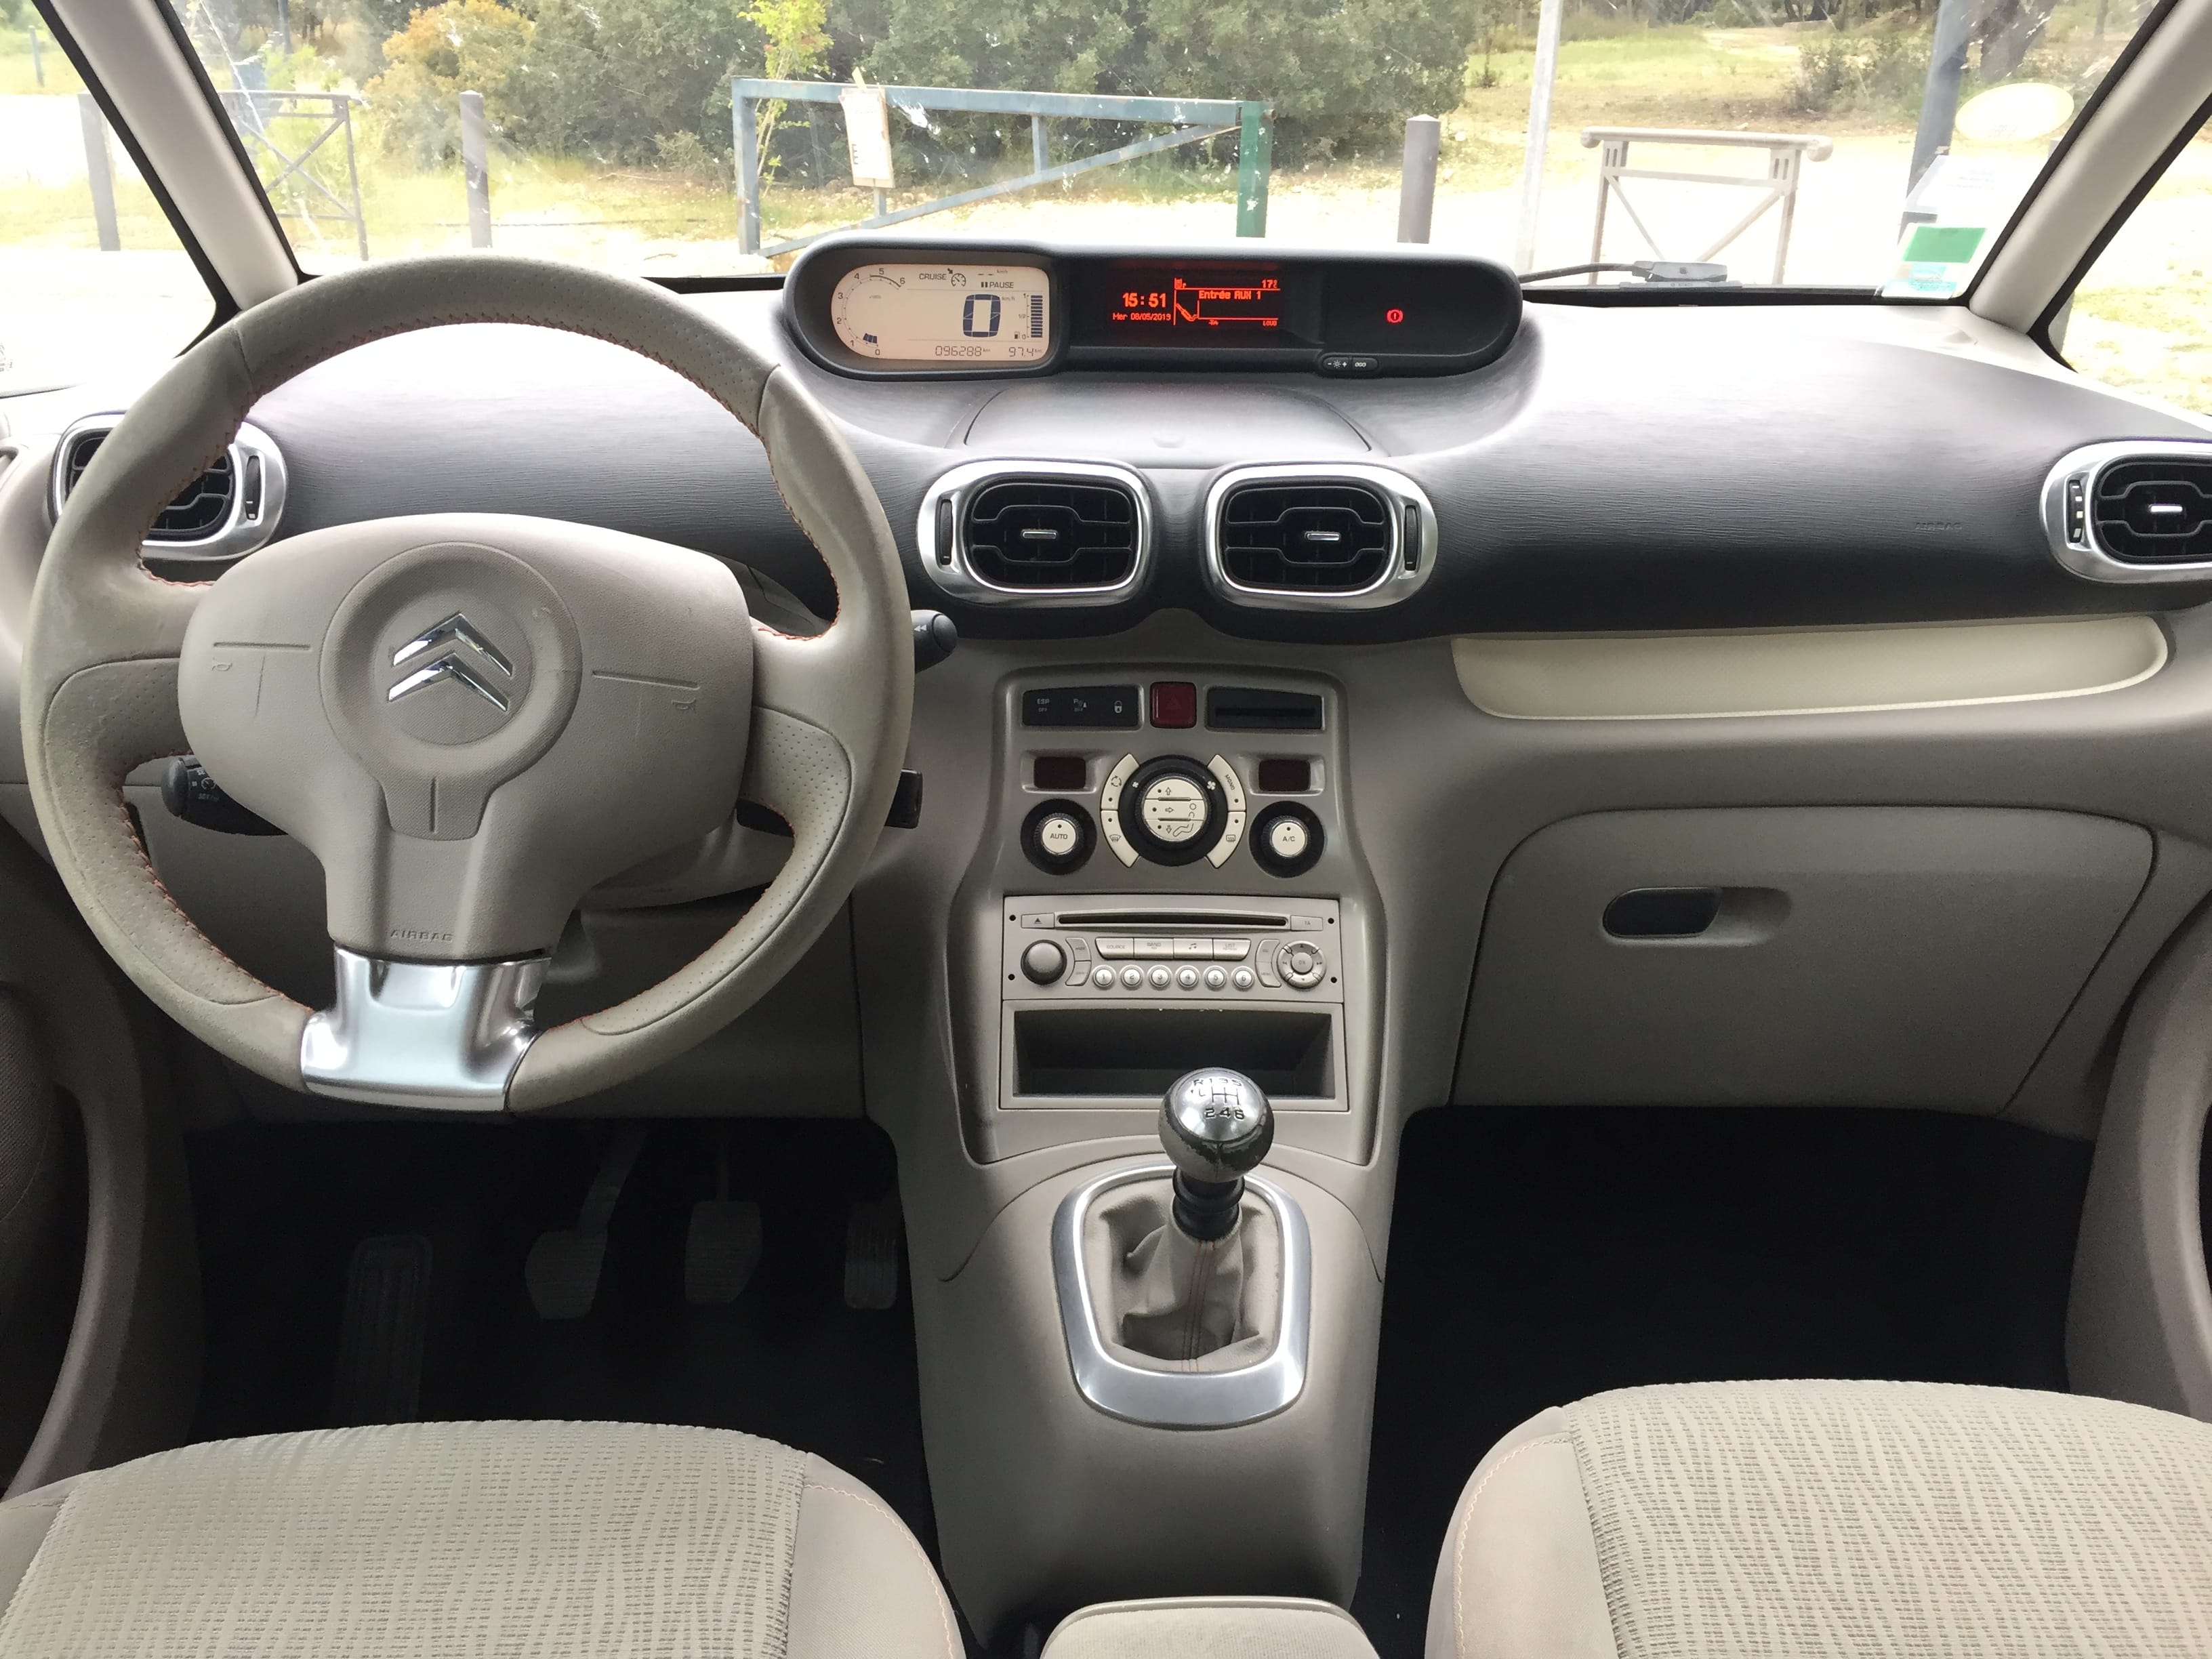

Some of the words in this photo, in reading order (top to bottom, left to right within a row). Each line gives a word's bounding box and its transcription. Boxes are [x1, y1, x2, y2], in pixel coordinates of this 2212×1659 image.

[918, 272, 947, 281] CRUISE
[1122, 292, 1166, 308] 15:51
[1198, 290, 1231, 300] Entrée
[1234, 290, 1252, 300] AUX
[1256, 290, 1261, 300] 1
[962, 293, 1001, 337] 0
[1112, 312, 1128, 321] Mer
[935, 346, 983, 356] 096288
[1008, 346, 1034, 357] 97.4
[1225, 774, 1235, 791] MONO
[390, 929, 454, 942] AIRBAG
[1205, 1107, 1215, 1118] 2
[1219, 1107, 1231, 1118] 4
